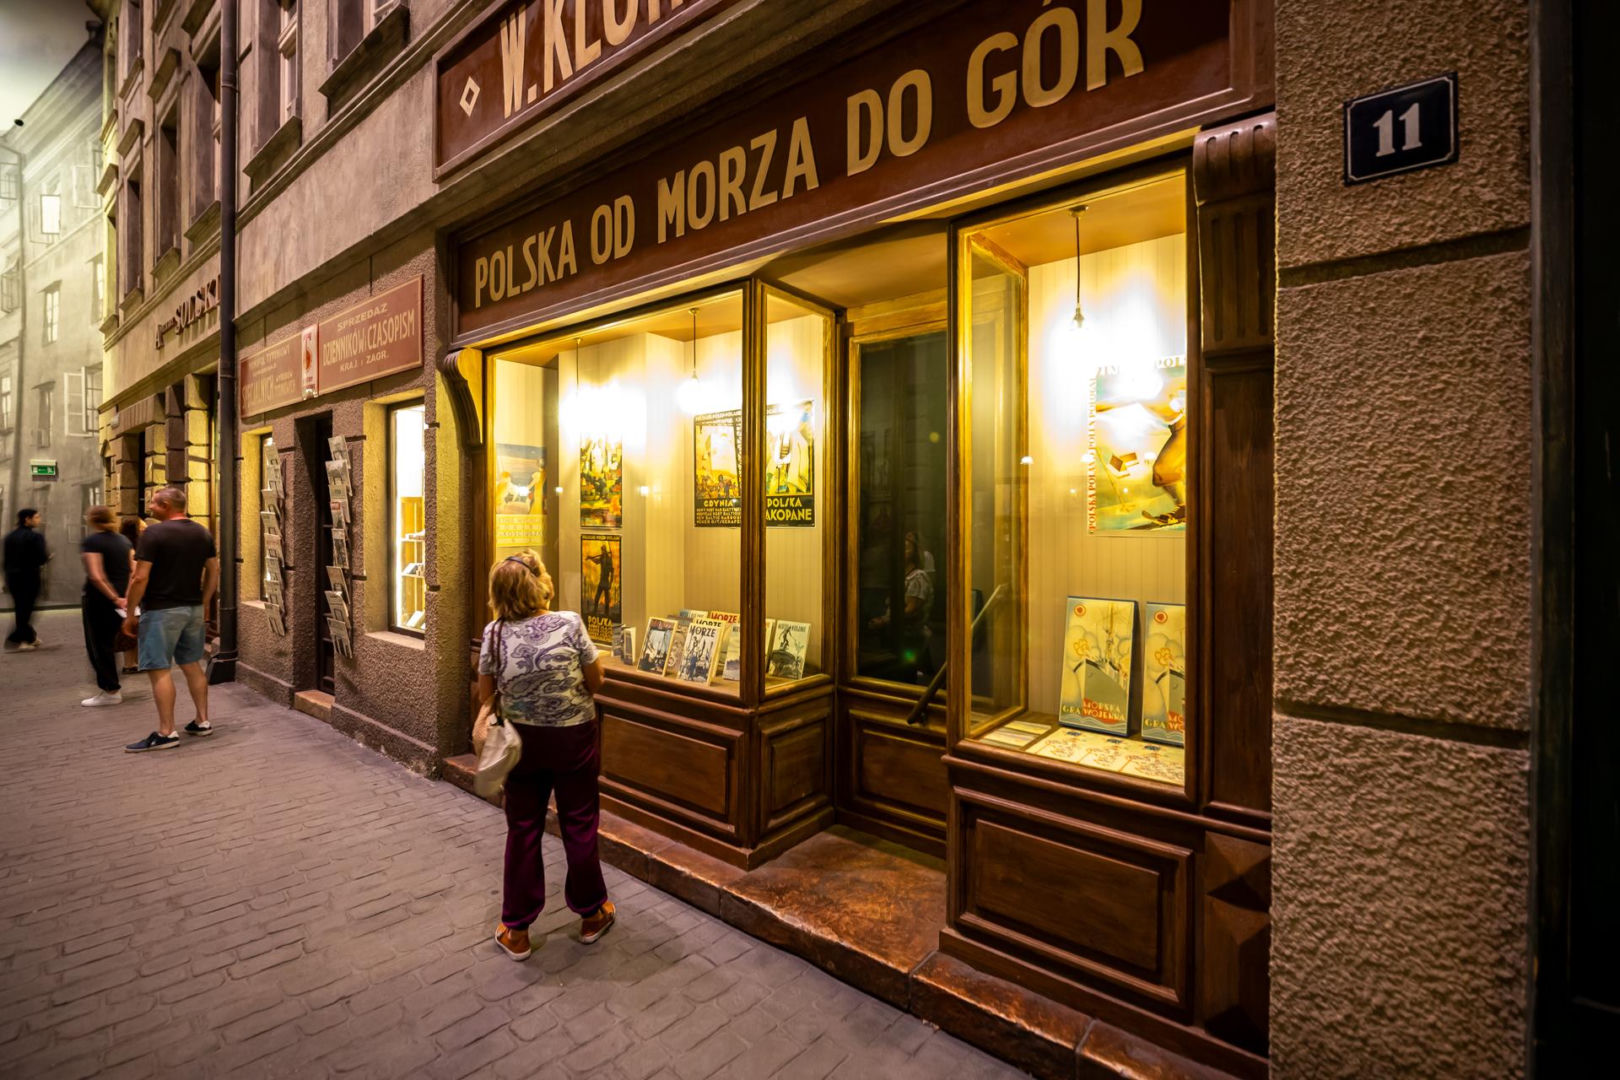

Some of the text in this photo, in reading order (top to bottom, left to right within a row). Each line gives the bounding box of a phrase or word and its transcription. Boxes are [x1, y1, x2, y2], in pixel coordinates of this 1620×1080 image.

[1372, 102, 1422, 157] 11
[475, 0, 1144, 308] POLSKA OD MORZA DO GÓR
[322, 325, 364, 366] DZIENNIKÓW
[367, 308, 415, 350] CZASOPISM
[340, 358, 358, 372] KRAJ
[766, 497, 802, 507] POLSKA
[766, 508, 812, 520] AKOPANE
[588, 615, 613, 627] POLSKA
[711, 612, 738, 624] MORZE
[690, 625, 717, 638] MORZE
[1062, 705, 1081, 715] GRA
[1144, 718, 1166, 728] GRA
